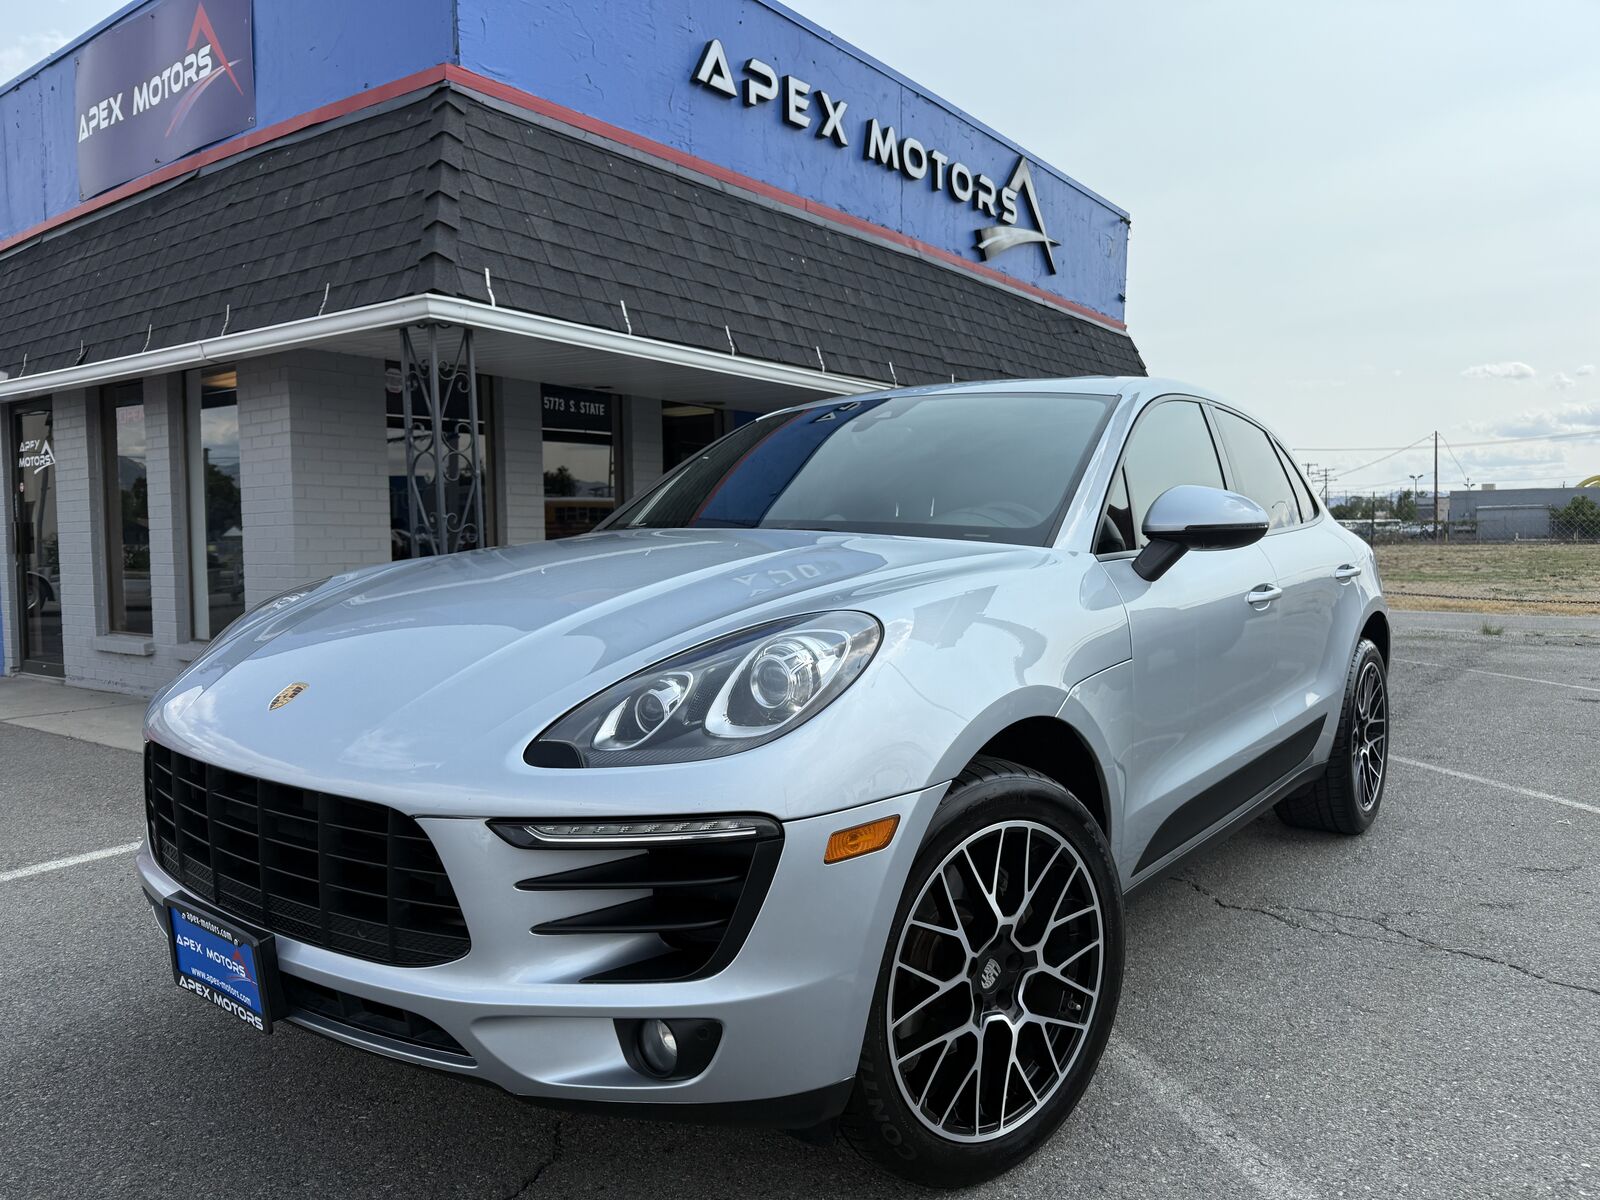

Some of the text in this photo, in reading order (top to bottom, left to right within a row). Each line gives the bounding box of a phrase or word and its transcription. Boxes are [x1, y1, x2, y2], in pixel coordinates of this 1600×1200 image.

[78, 44, 212, 143] APEX MOTORS
[690, 38, 1018, 224] APEX MOTORS
[543, 396, 605, 416] 5773 S. STATE
[19, 455, 50, 467] MOTORS
[176, 934, 246, 978] APEX MOTORS
[179, 975, 264, 1031] APEX MOTORS
[190, 967, 252, 1006] www.apex-motors.com
